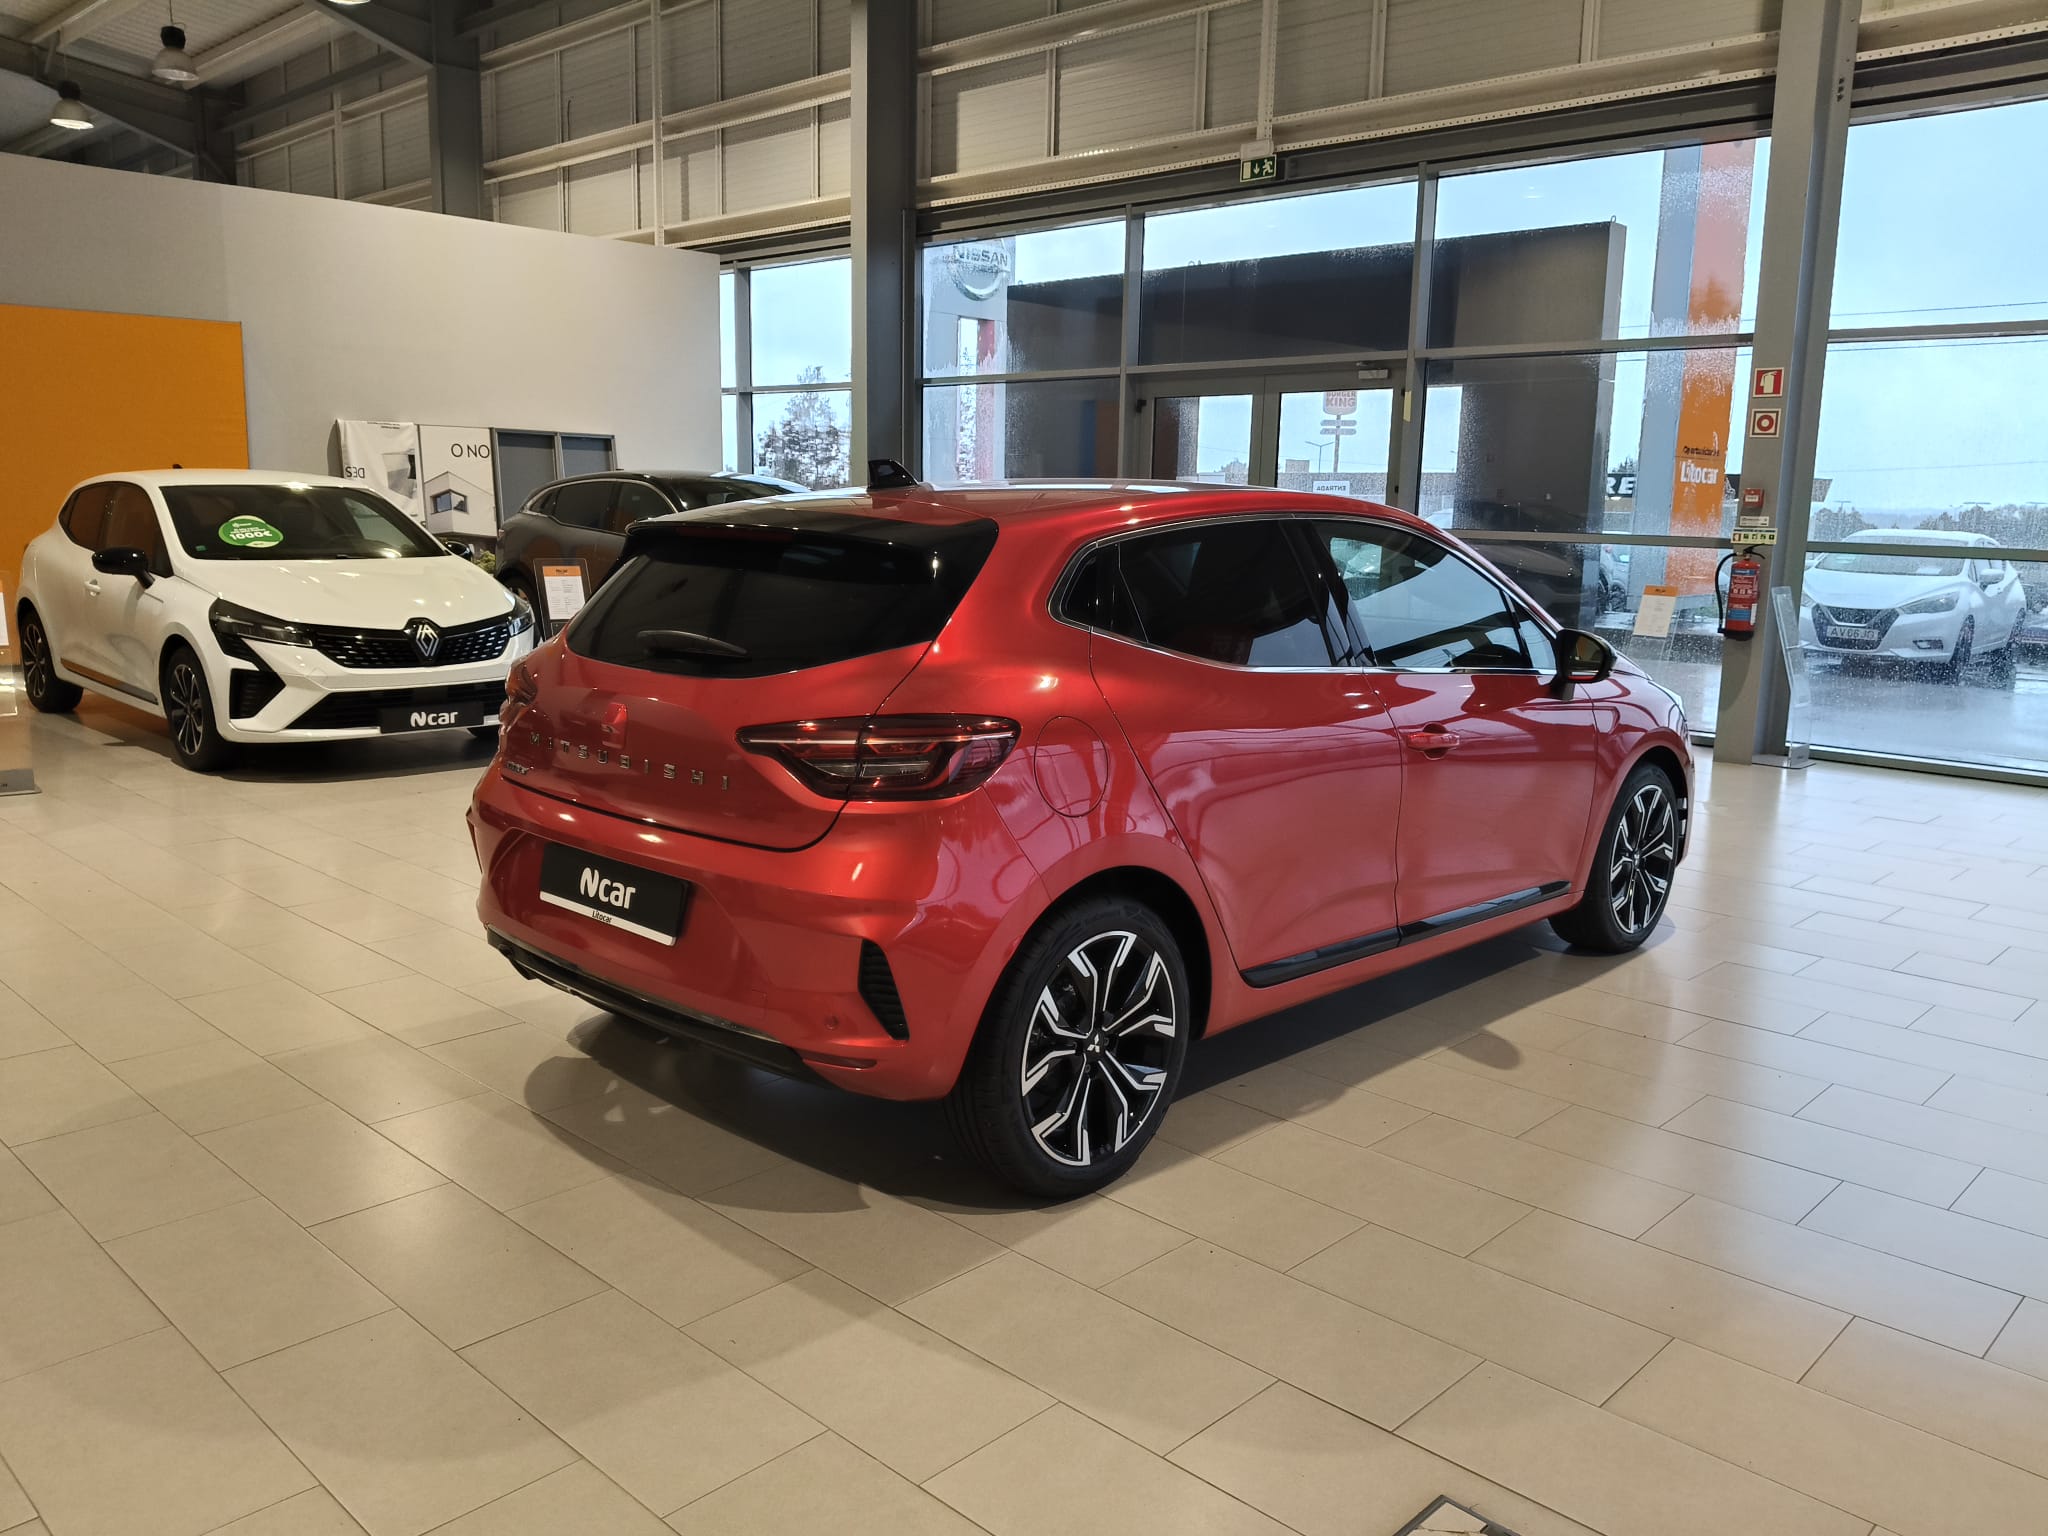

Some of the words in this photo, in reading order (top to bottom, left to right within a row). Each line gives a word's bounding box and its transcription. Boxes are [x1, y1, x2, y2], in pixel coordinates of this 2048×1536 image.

[952, 245, 1008, 266] NISSAN
[1326, 398, 1355, 407] KING
[451, 443, 463, 457] O
[467, 444, 490, 459] NO
[1680, 460, 1718, 484] Litocar
[410, 711, 458, 727] Ncar
[530, 731, 729, 791] MITSUBISHI
[580, 867, 636, 909] Ncar
[592, 910, 613, 924] Litocar
